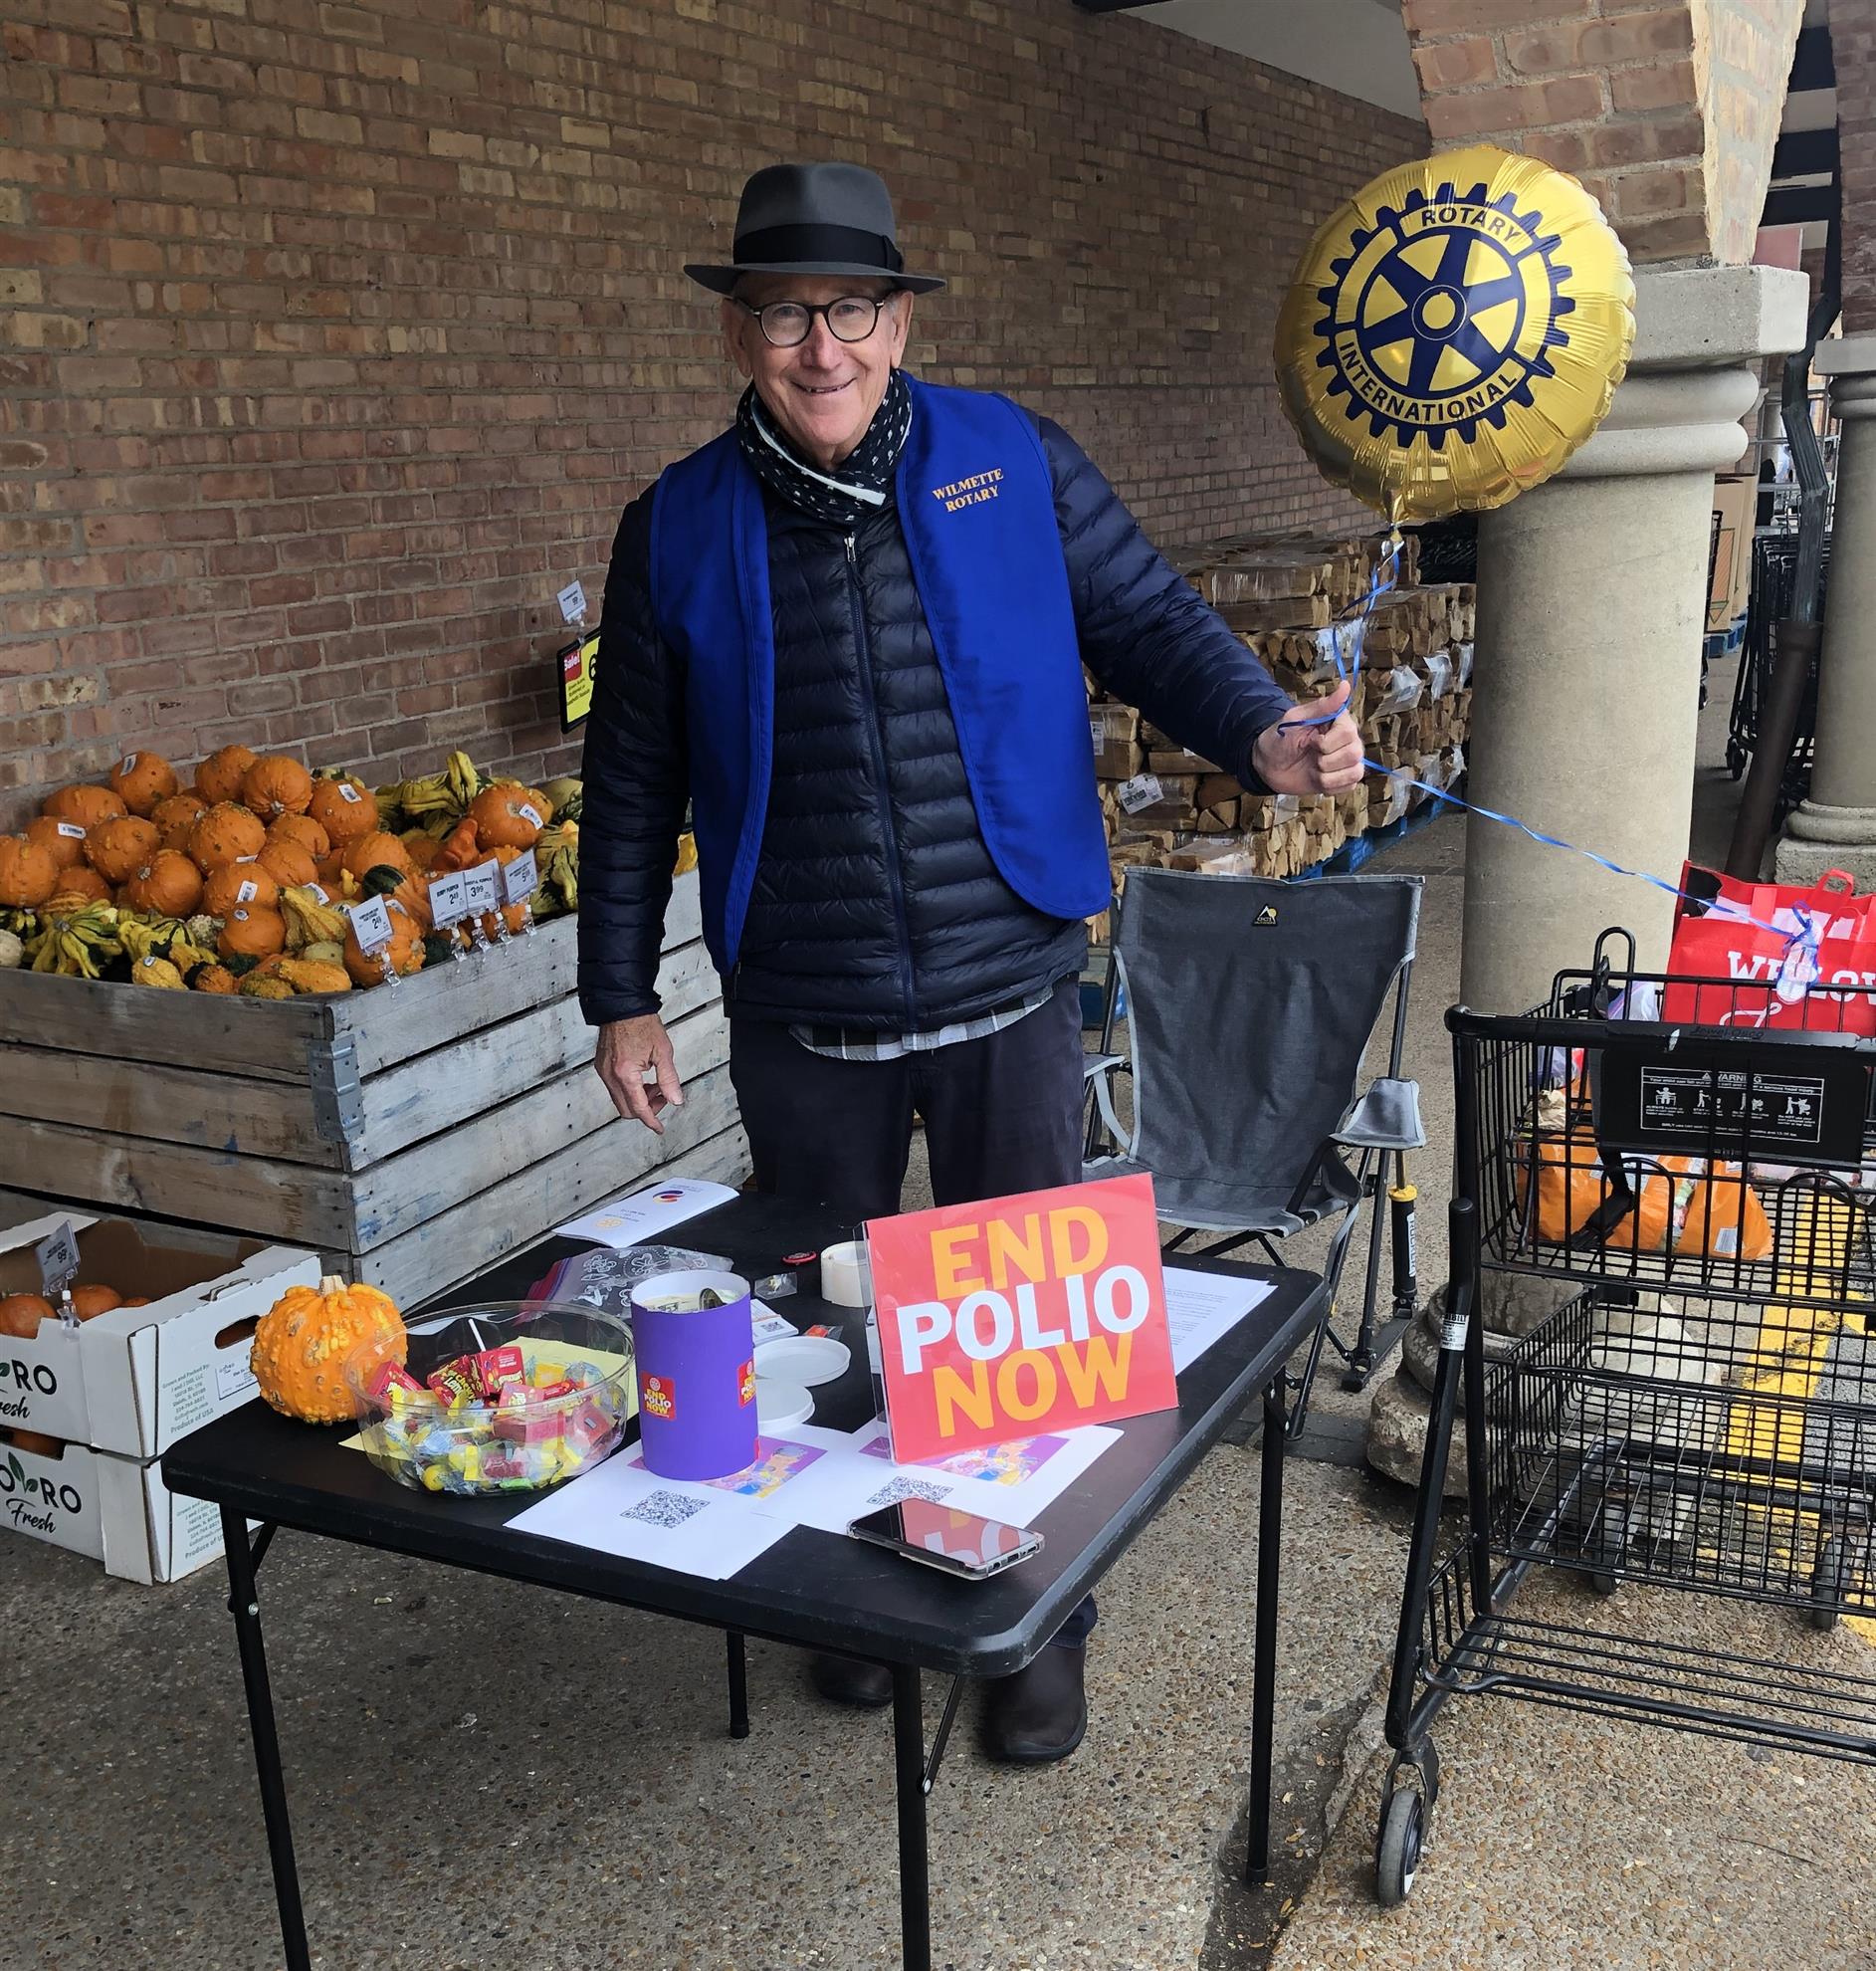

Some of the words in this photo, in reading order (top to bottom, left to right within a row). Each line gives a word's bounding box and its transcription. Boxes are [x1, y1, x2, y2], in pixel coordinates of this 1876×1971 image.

[1421, 207, 1521, 242] ROTARY
[1339, 341, 1518, 422] INTERNATIONAL
[933, 468, 1003, 500] WILMETTE
[945, 485, 999, 513] ROTARY
[1718, 1074, 1762, 1084] ARNIG
[930, 1205, 1110, 1301] END
[896, 1264, 1150, 1375] POLIO
[644, 1393, 672, 1409] POLIO
[646, 1388, 666, 1401] END
[933, 1331, 1134, 1439] NOW
[646, 1401, 669, 1415] NOW
[6, 1498, 56, 1534] Fresh
